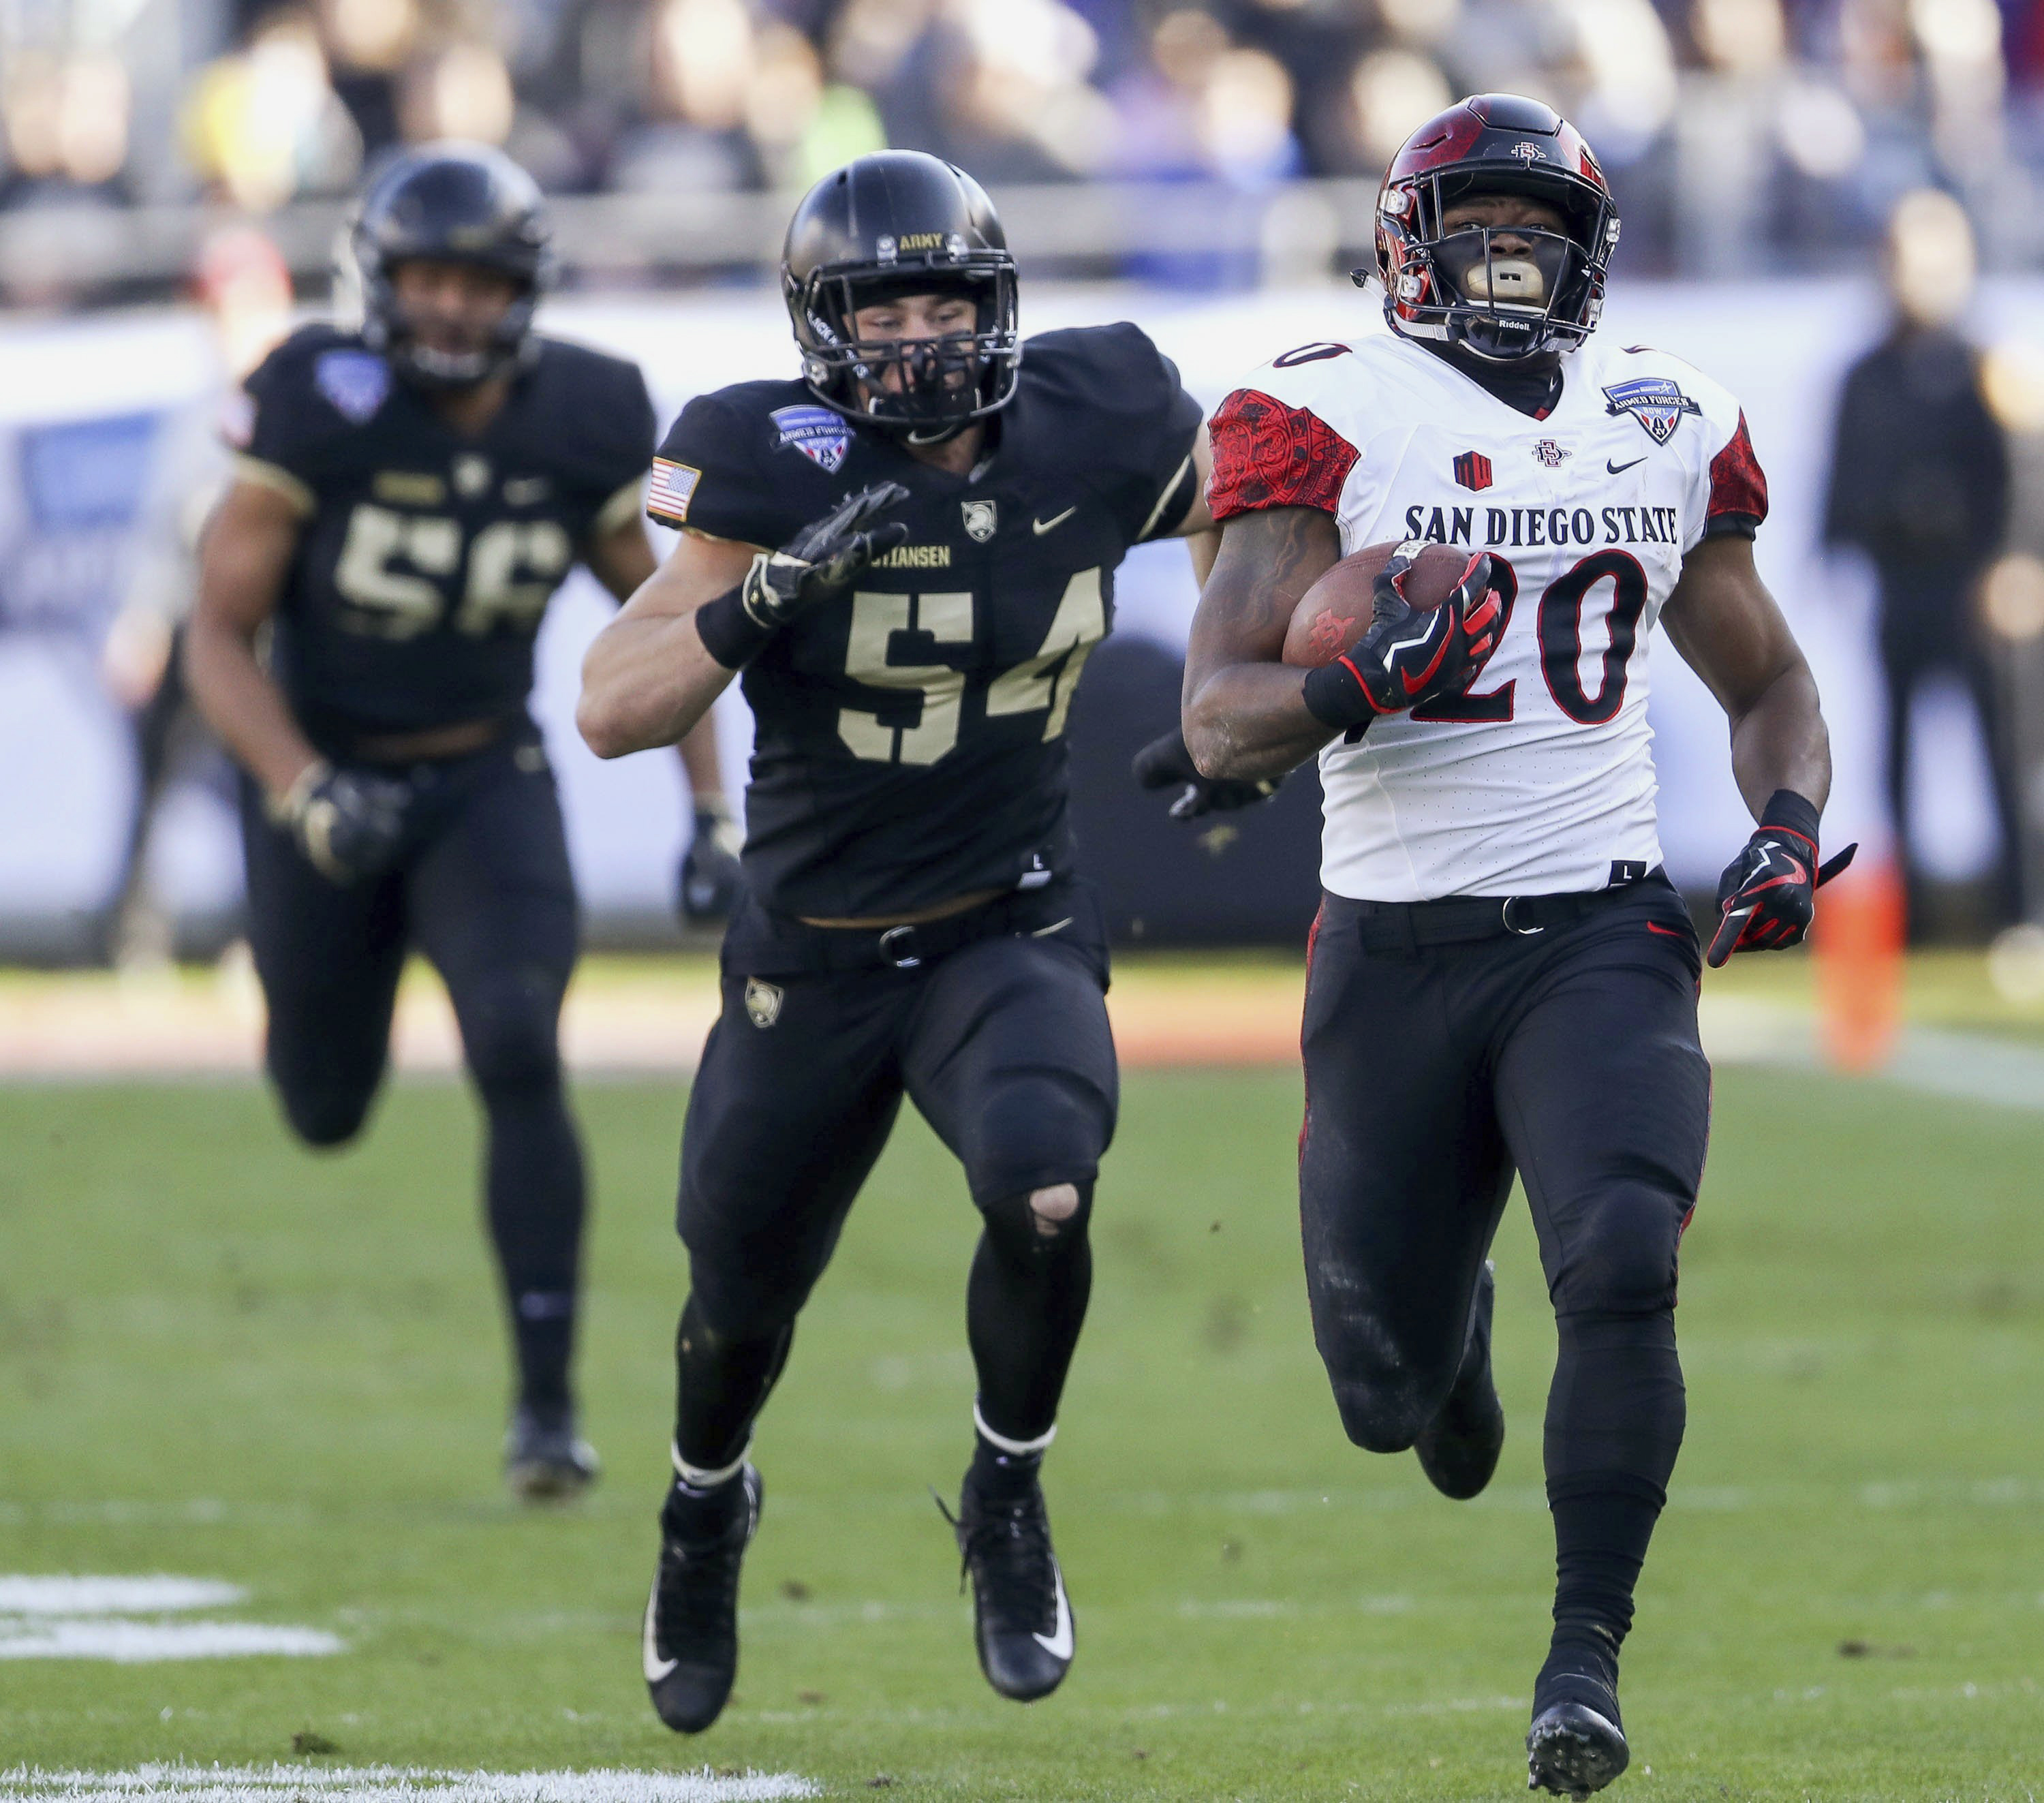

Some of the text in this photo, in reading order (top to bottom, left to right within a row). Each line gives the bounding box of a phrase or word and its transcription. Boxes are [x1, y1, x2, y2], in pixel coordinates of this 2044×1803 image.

[899, 233, 943, 250] ARMY
[1499, 320, 1530, 331] Riddell
[1614, 395, 1689, 410] ARMED FORCES
[1643, 407, 1669, 415] BOWL
[1655, 427, 1665, 435] XV
[1404, 506, 1677, 546] SAN DIEGO STATE
[334, 503, 571, 641] 56
[1410, 549, 1648, 724] 20
[837, 566, 1106, 766] 54
[1623, 865, 1632, 880] L
